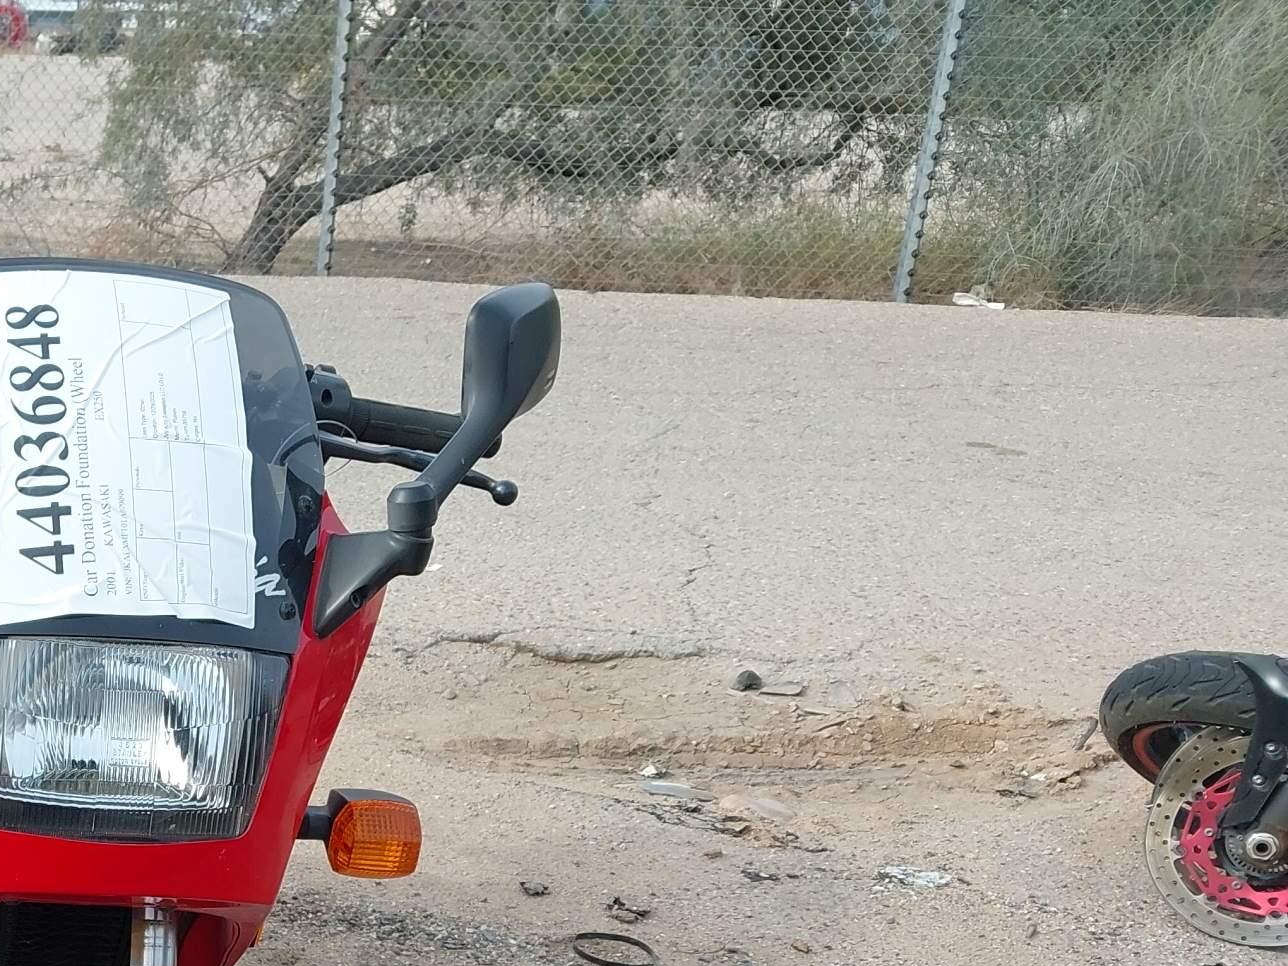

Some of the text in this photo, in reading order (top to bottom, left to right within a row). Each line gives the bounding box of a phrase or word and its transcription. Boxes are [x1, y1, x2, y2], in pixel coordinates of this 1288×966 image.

[5, 304, 75, 575] 44036848
[67, 357, 99, 597] Car Donation Foundation (Wheel
[99, 484, 114, 547] KAWASAKI
[106, 572, 117, 596] 2001
